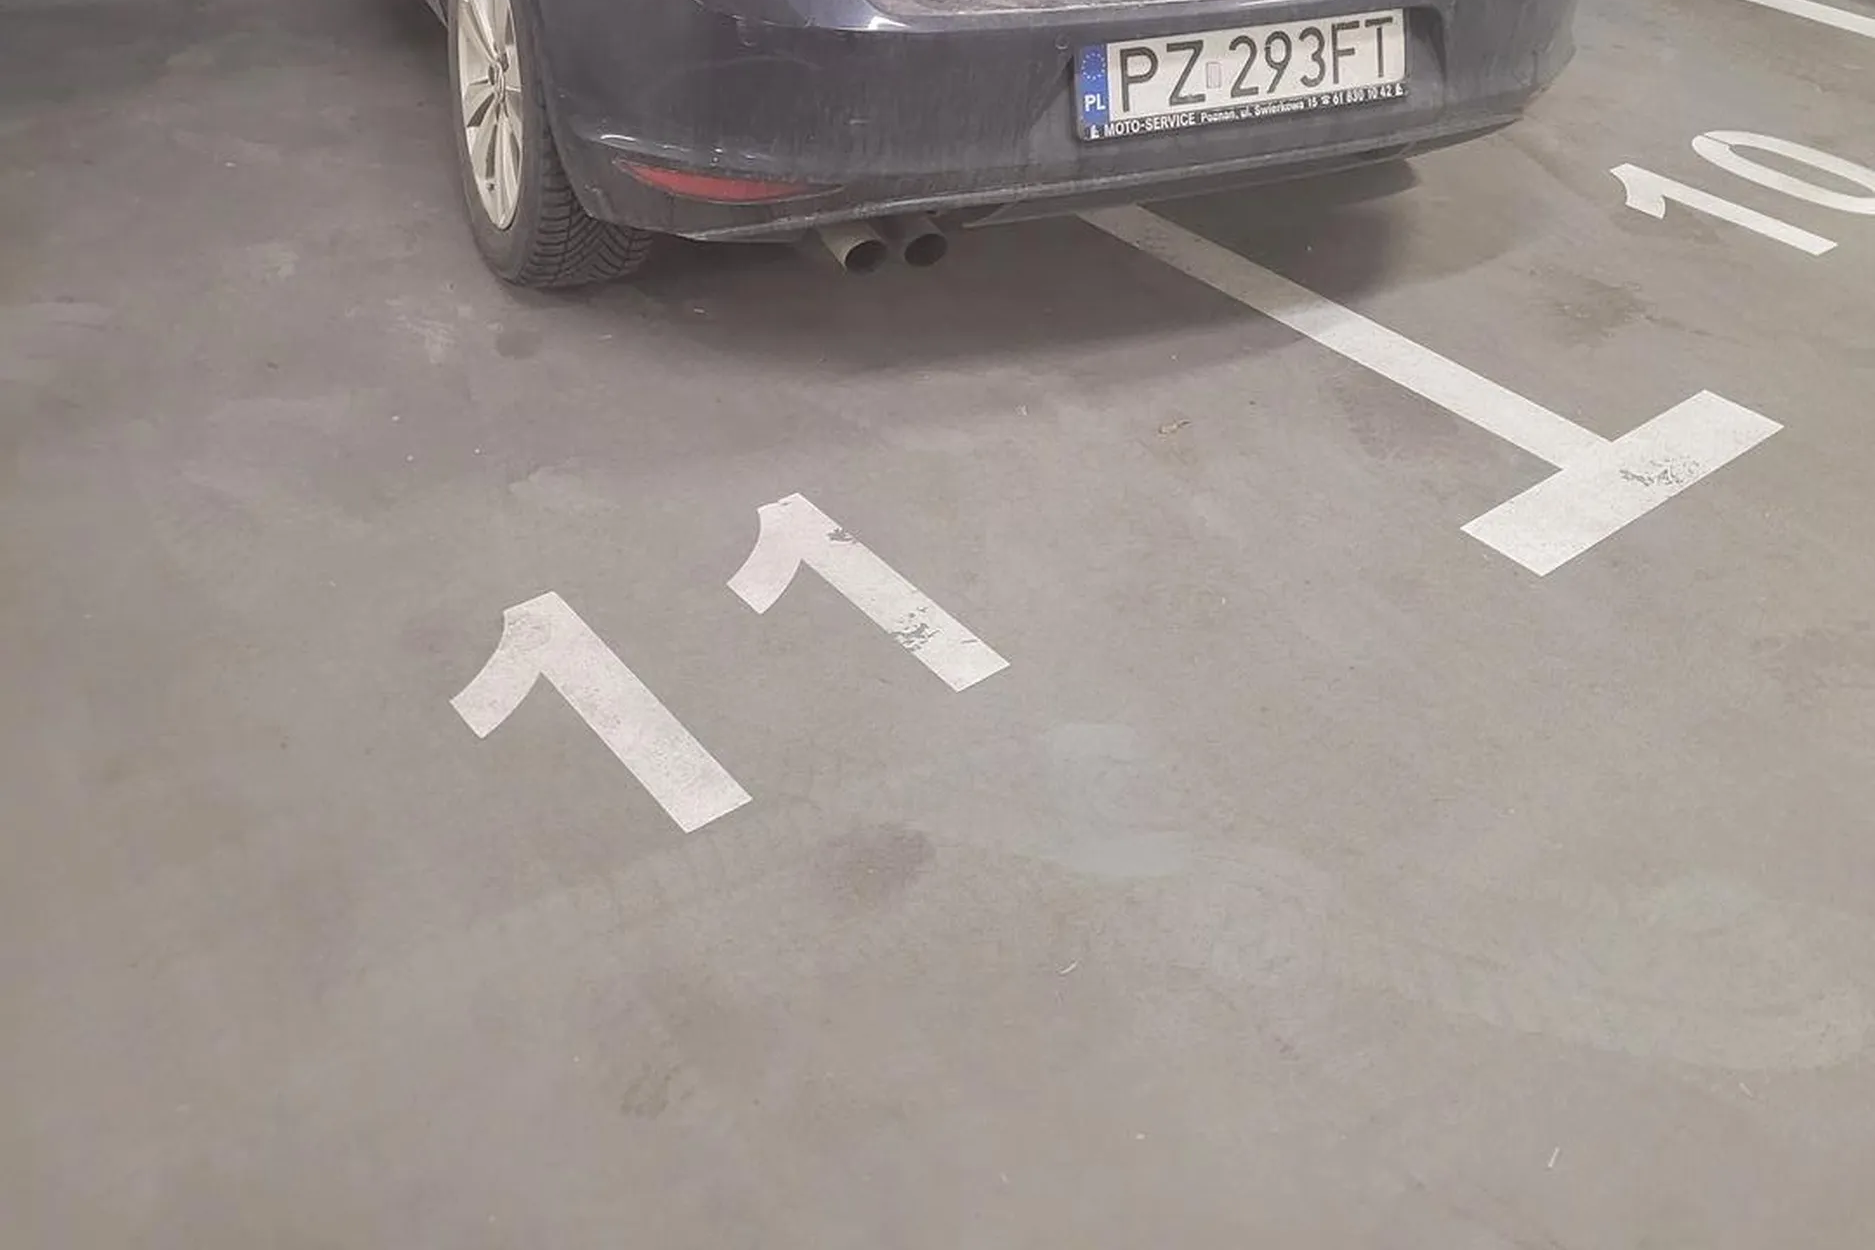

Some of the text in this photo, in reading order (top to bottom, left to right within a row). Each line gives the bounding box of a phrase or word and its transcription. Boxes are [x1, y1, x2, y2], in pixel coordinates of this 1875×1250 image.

[1084, 93, 1106, 112] PL
[1104, 111, 1196, 137] MOTO-SERVICE
[1332, 92, 1343, 105] 61
[1380, 84, 1393, 97] 42
[1119, 17, 1394, 112] PZ 293FT
[1609, 129, 1875, 256] 10
[449, 492, 1010, 833] 11
